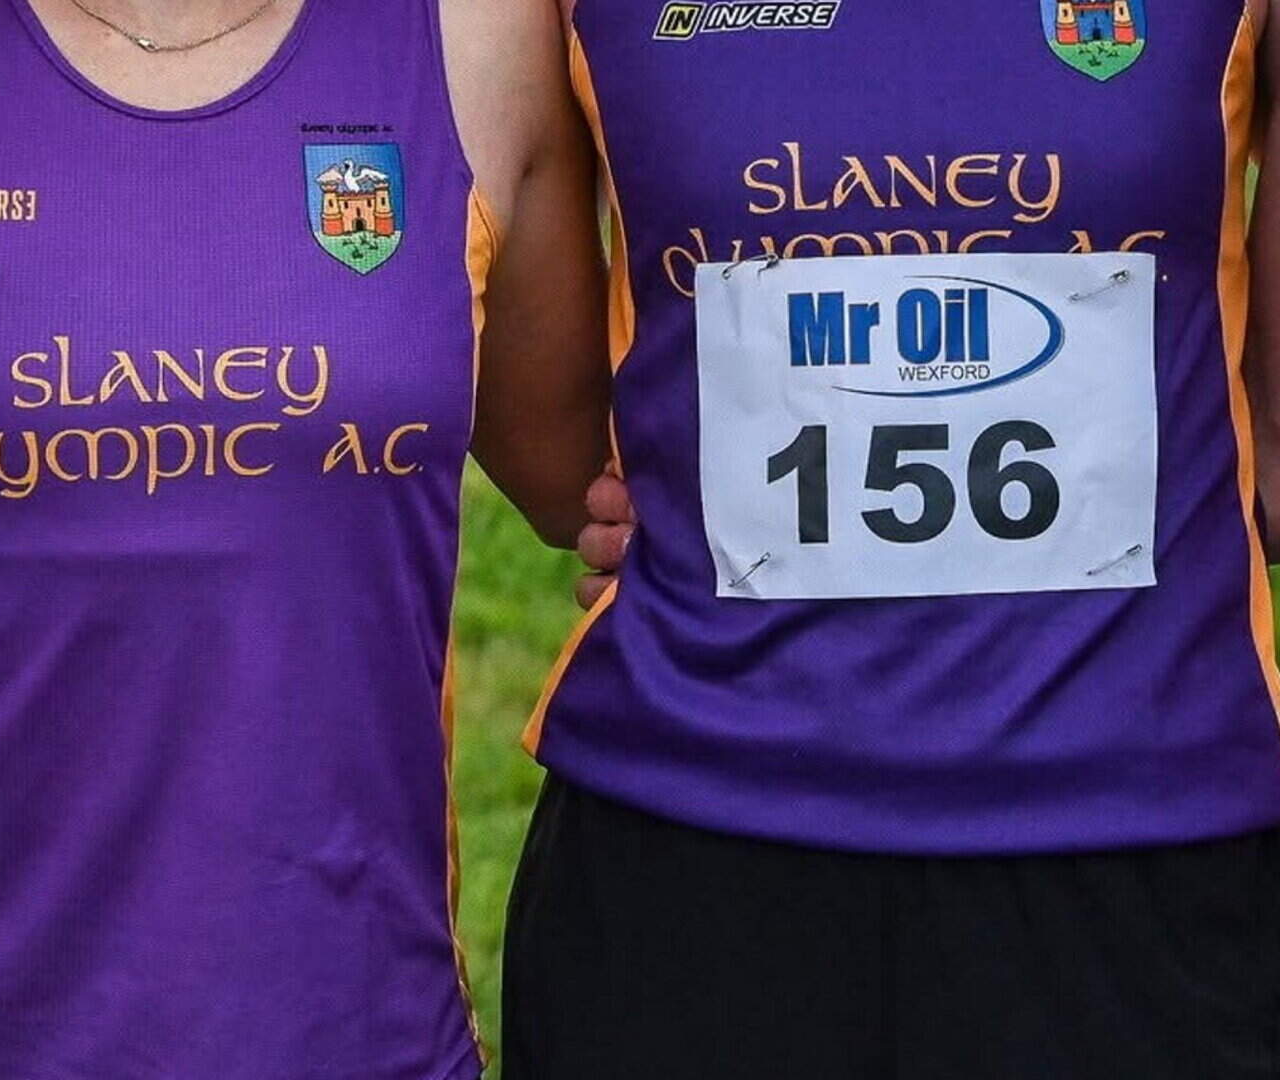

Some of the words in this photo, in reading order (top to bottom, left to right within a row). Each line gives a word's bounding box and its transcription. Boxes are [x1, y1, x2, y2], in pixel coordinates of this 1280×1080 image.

[707, 4, 833, 27] INVERSE
[743, 142, 1061, 223] SLANEY
[787, 291, 880, 366] Mr
[897, 287, 989, 365] Oil
[10, 336, 329, 416] SLANEY
[898, 364, 990, 382] WEXFORD
[322, 423, 429, 475] A.C.
[767, 420, 1060, 544] 156
